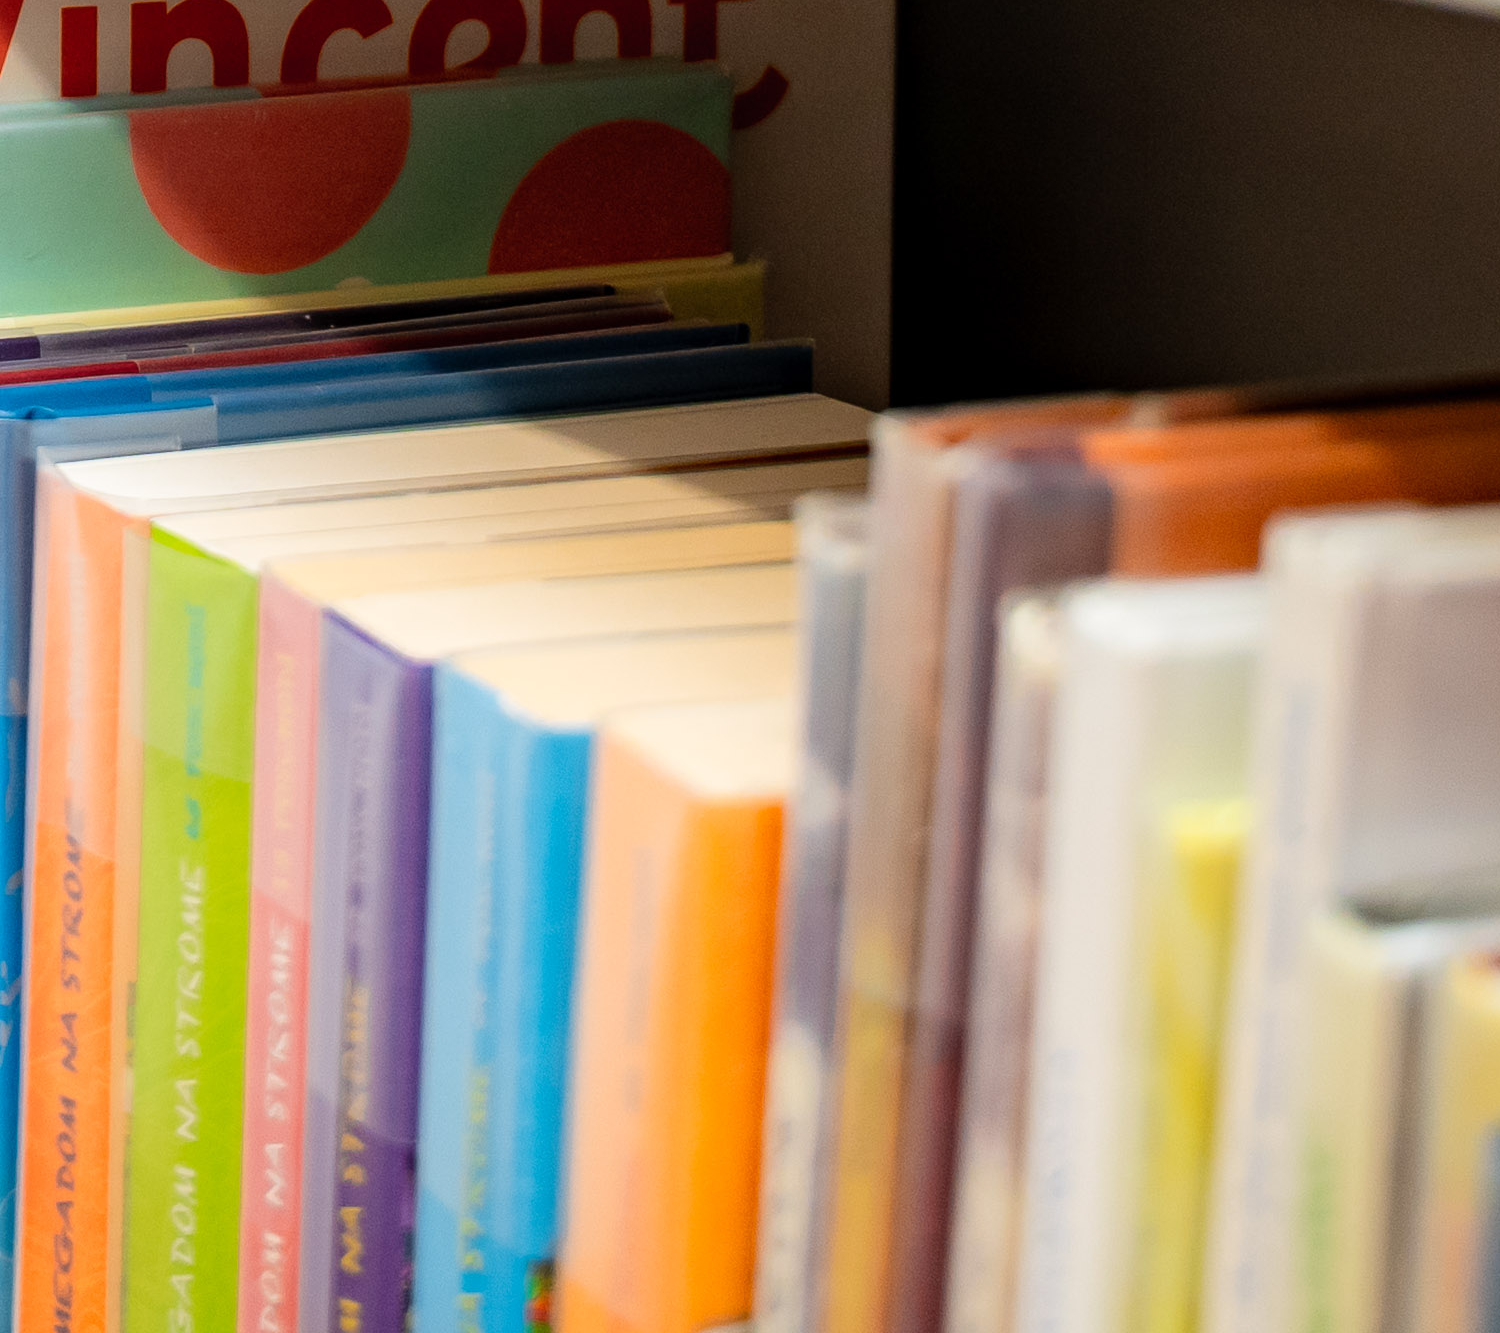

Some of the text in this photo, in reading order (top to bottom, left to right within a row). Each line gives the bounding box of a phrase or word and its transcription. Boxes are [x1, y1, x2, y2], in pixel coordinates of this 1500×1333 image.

[174, 857, 205, 1057] STROME
[60, 1012, 80, 1073] NA
[174, 1080, 200, 1141] NA
[263, 1143, 286, 1206] NA
